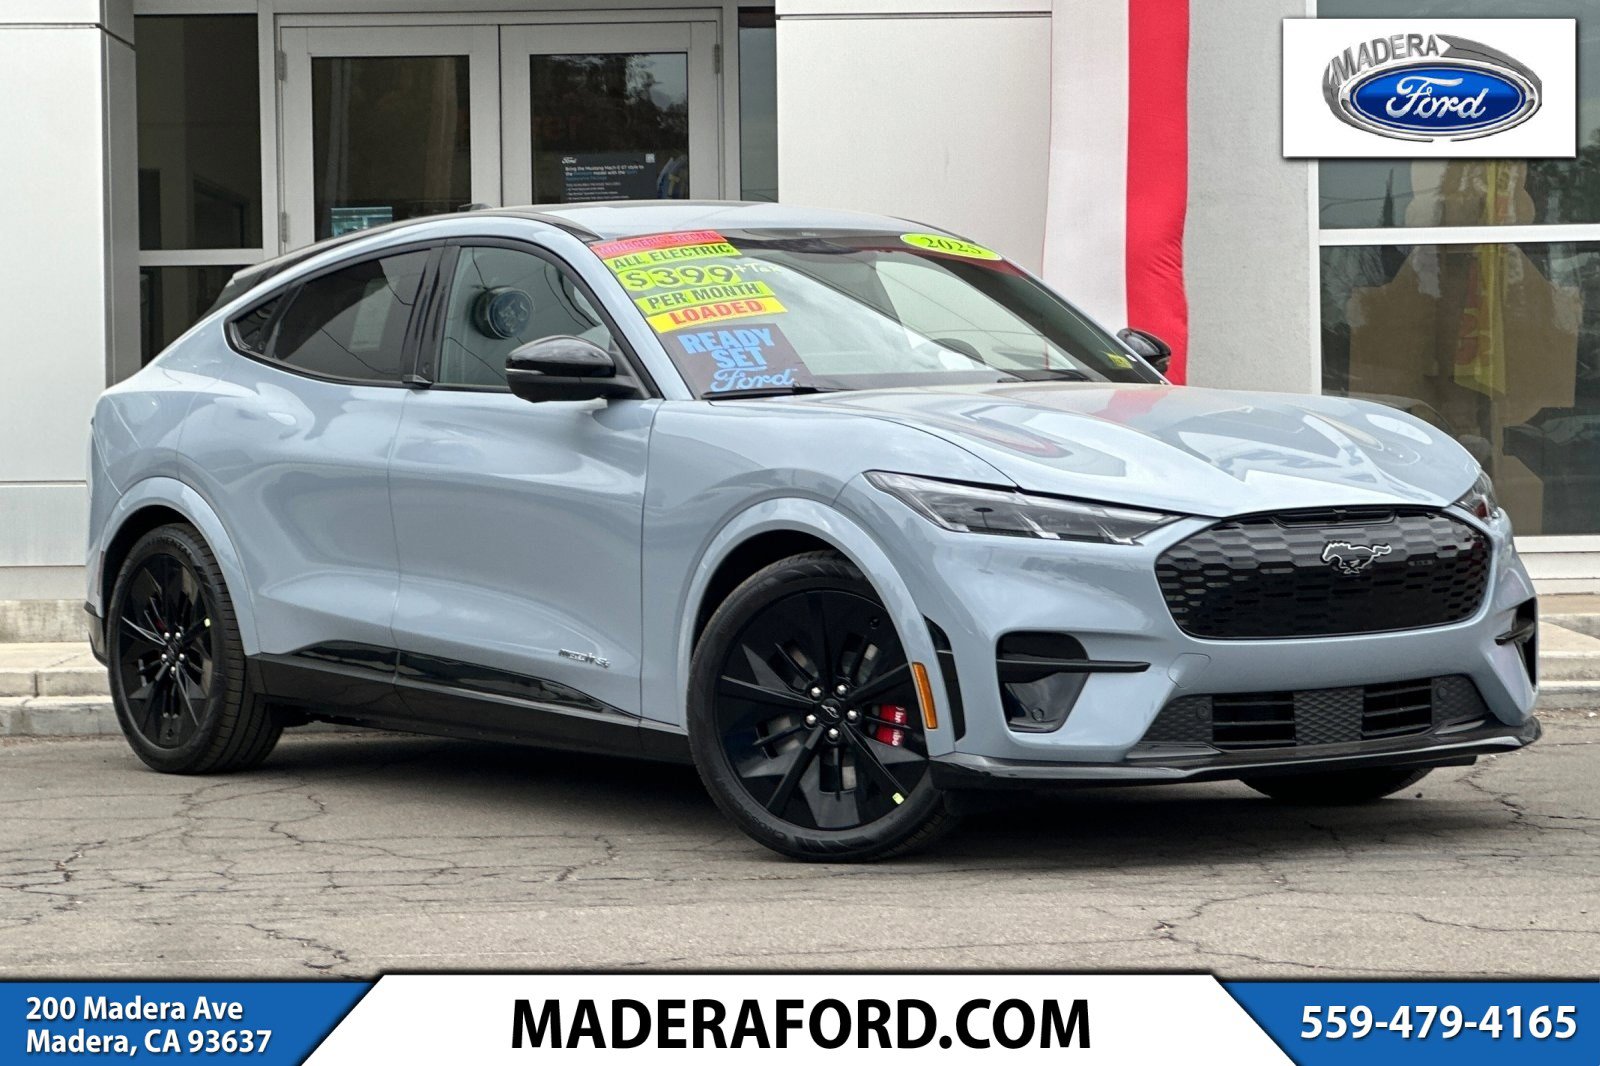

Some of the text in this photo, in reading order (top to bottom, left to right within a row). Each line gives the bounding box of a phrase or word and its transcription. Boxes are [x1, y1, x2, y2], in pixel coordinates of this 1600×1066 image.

[670, 231, 717, 244] SPECIAL
[920, 236, 982, 255] 2025
[613, 244, 730, 269] ALL ELECTRIC
[625, 265, 734, 288] $399
[649, 282, 760, 309] PER MONTH
[669, 300, 766, 325] LOADED
[677, 327, 776, 354] READY
[711, 348, 768, 369] SET
[710, 366, 796, 392] Ford
